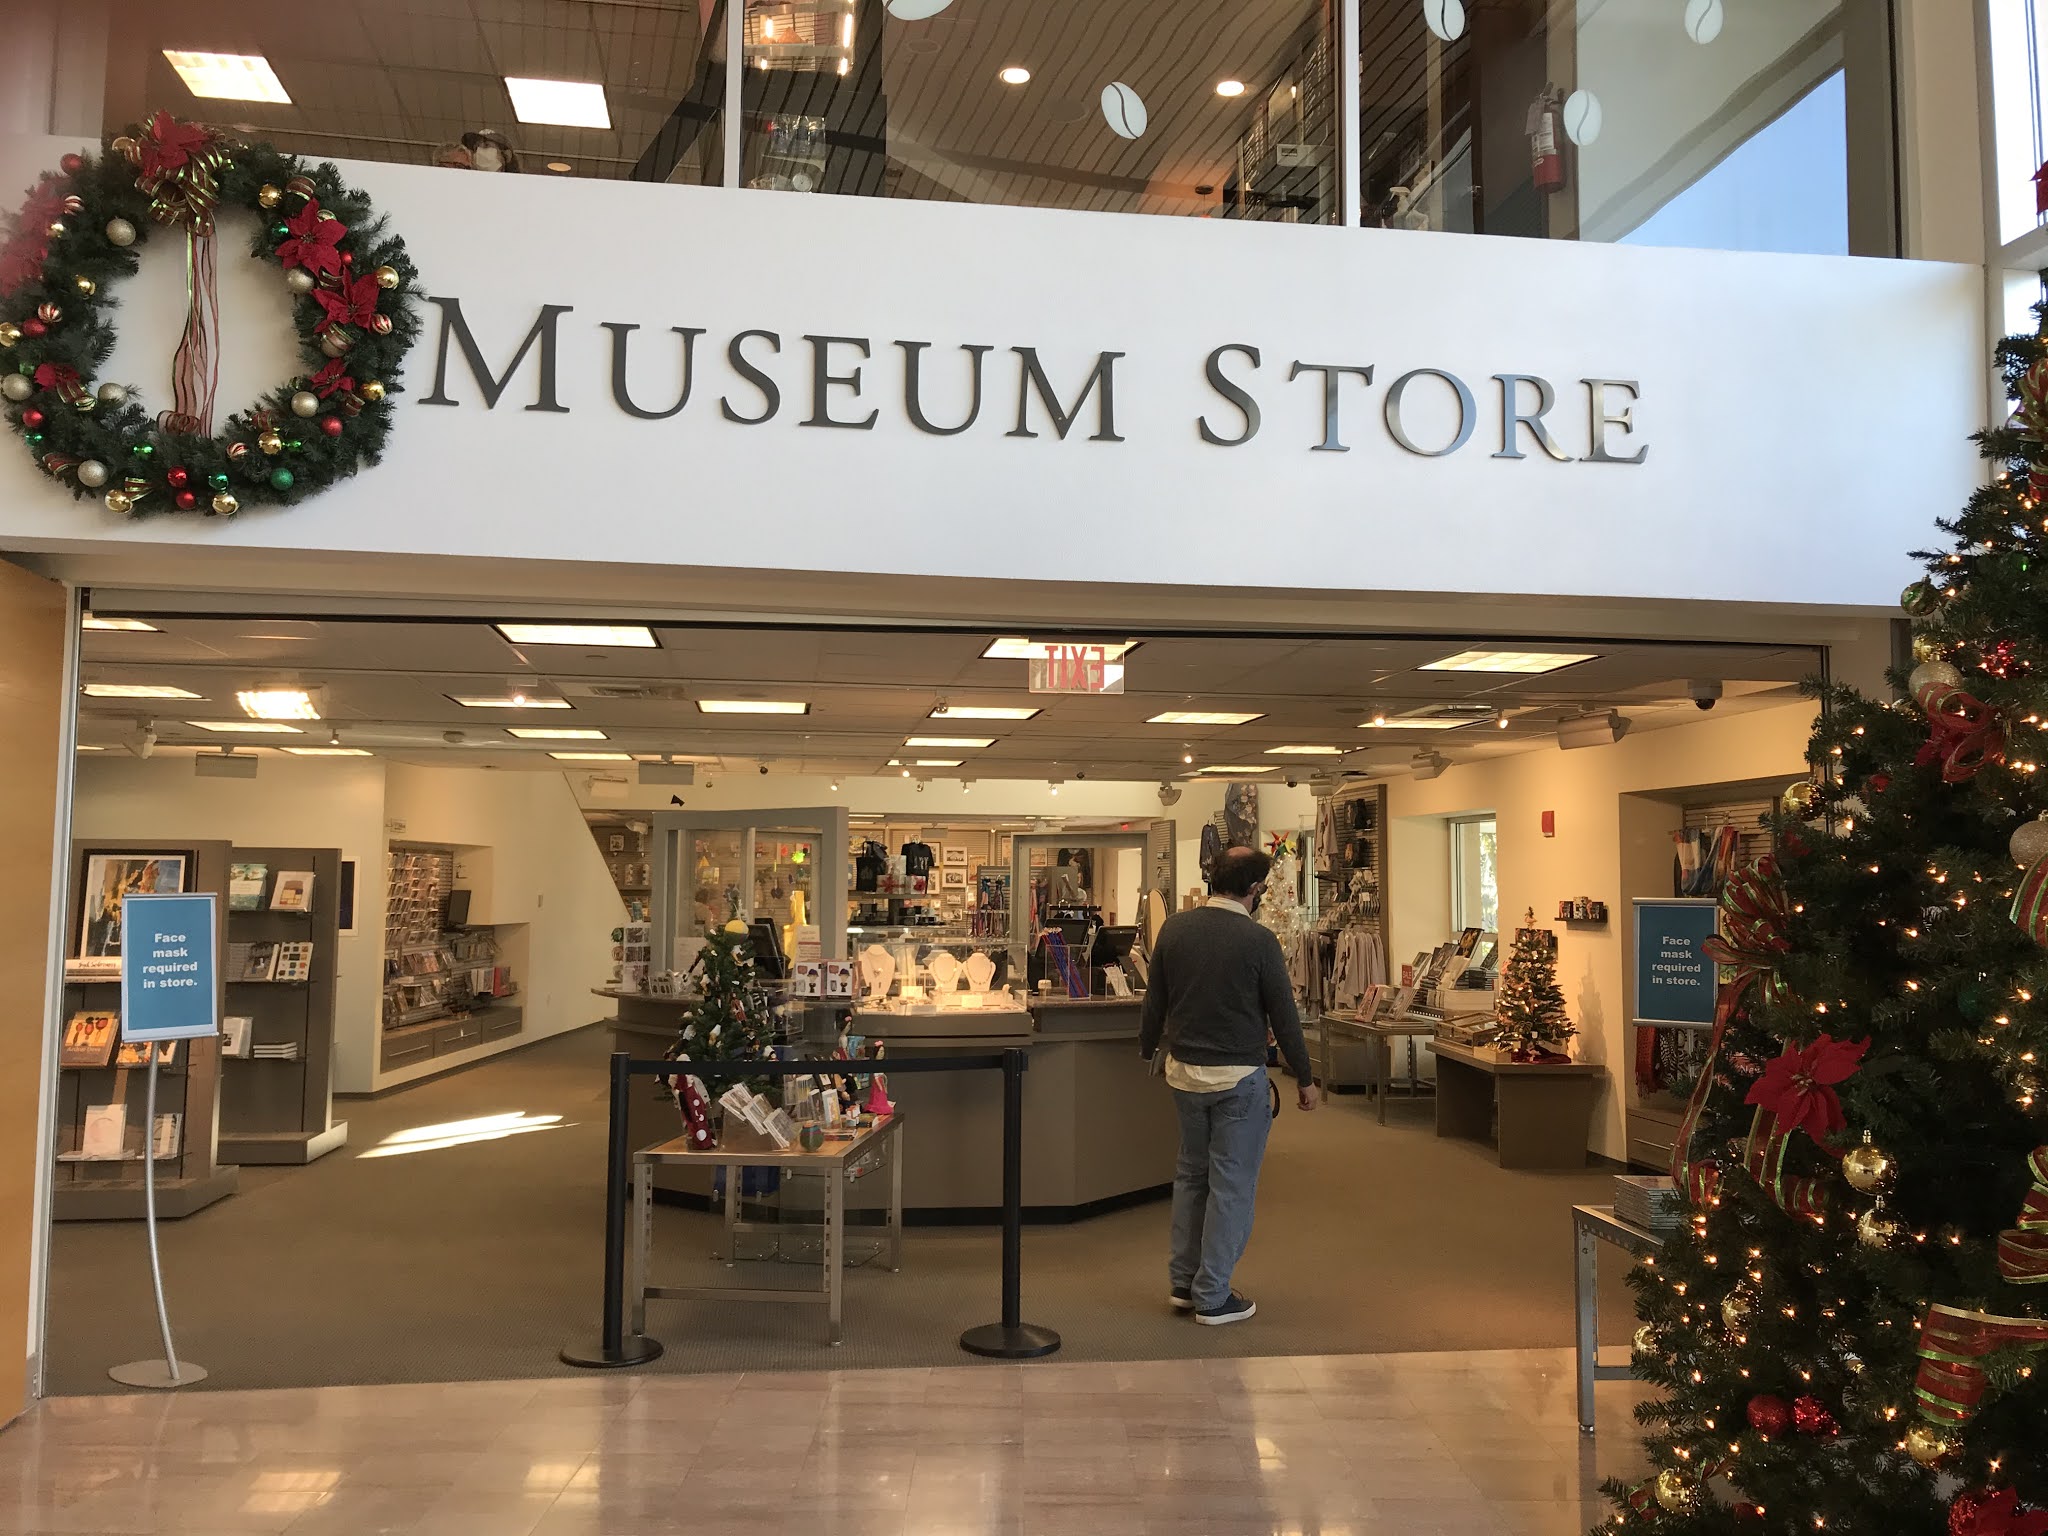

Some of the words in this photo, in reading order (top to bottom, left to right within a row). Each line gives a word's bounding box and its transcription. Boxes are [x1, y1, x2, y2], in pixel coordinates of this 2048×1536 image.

[418, 297, 1126, 442] MUSEUM
[1196, 343, 1650, 464] STORE
[154, 933, 186, 943] Face
[1662, 936, 1691, 946] Face
[152, 947, 188, 958] mask
[1660, 950, 1693, 959] mask
[142, 961, 198, 975] required
[1651, 963, 1701, 973] required
[143, 978, 156, 989] in
[159, 978, 198, 988] store.
[1652, 975, 1663, 984] in
[1666, 976, 1701, 986] store.
